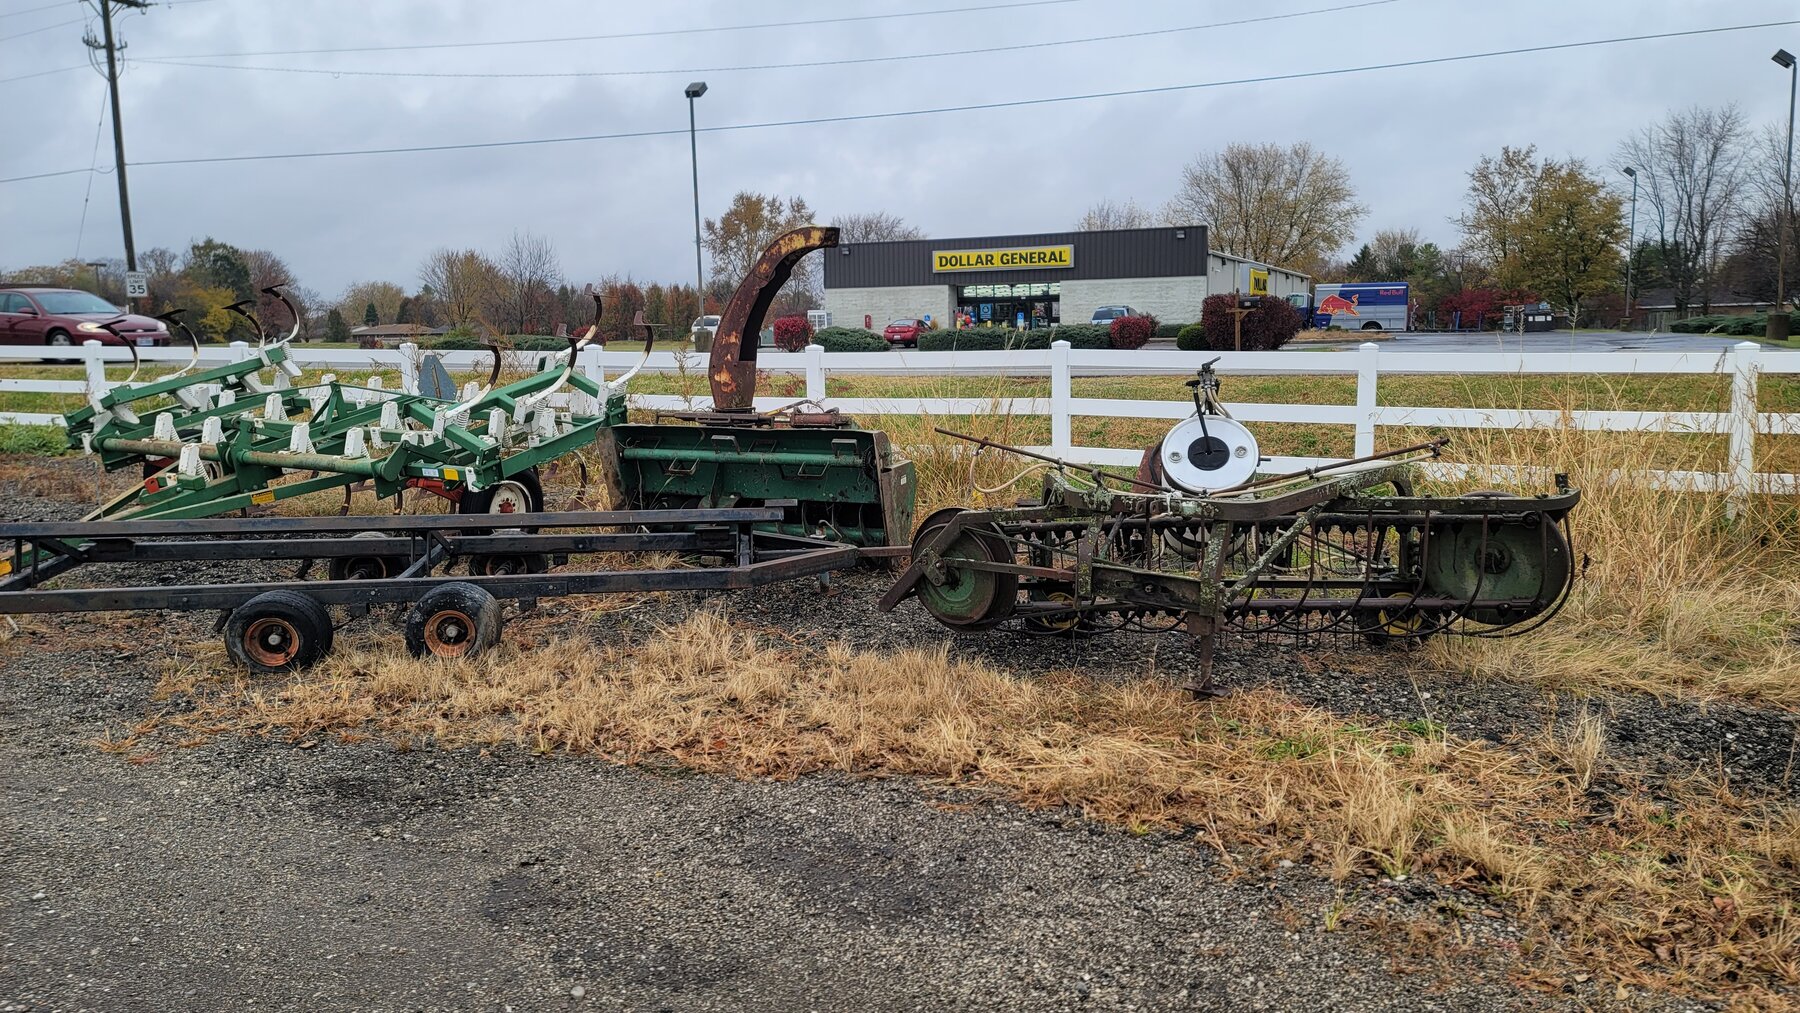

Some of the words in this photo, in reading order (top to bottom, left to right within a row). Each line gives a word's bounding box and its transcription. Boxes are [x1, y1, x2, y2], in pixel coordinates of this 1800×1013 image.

[938, 253, 995, 267] DOLLAR
[1000, 250, 1067, 265] GENERAL
[129, 284, 145, 294] 35
